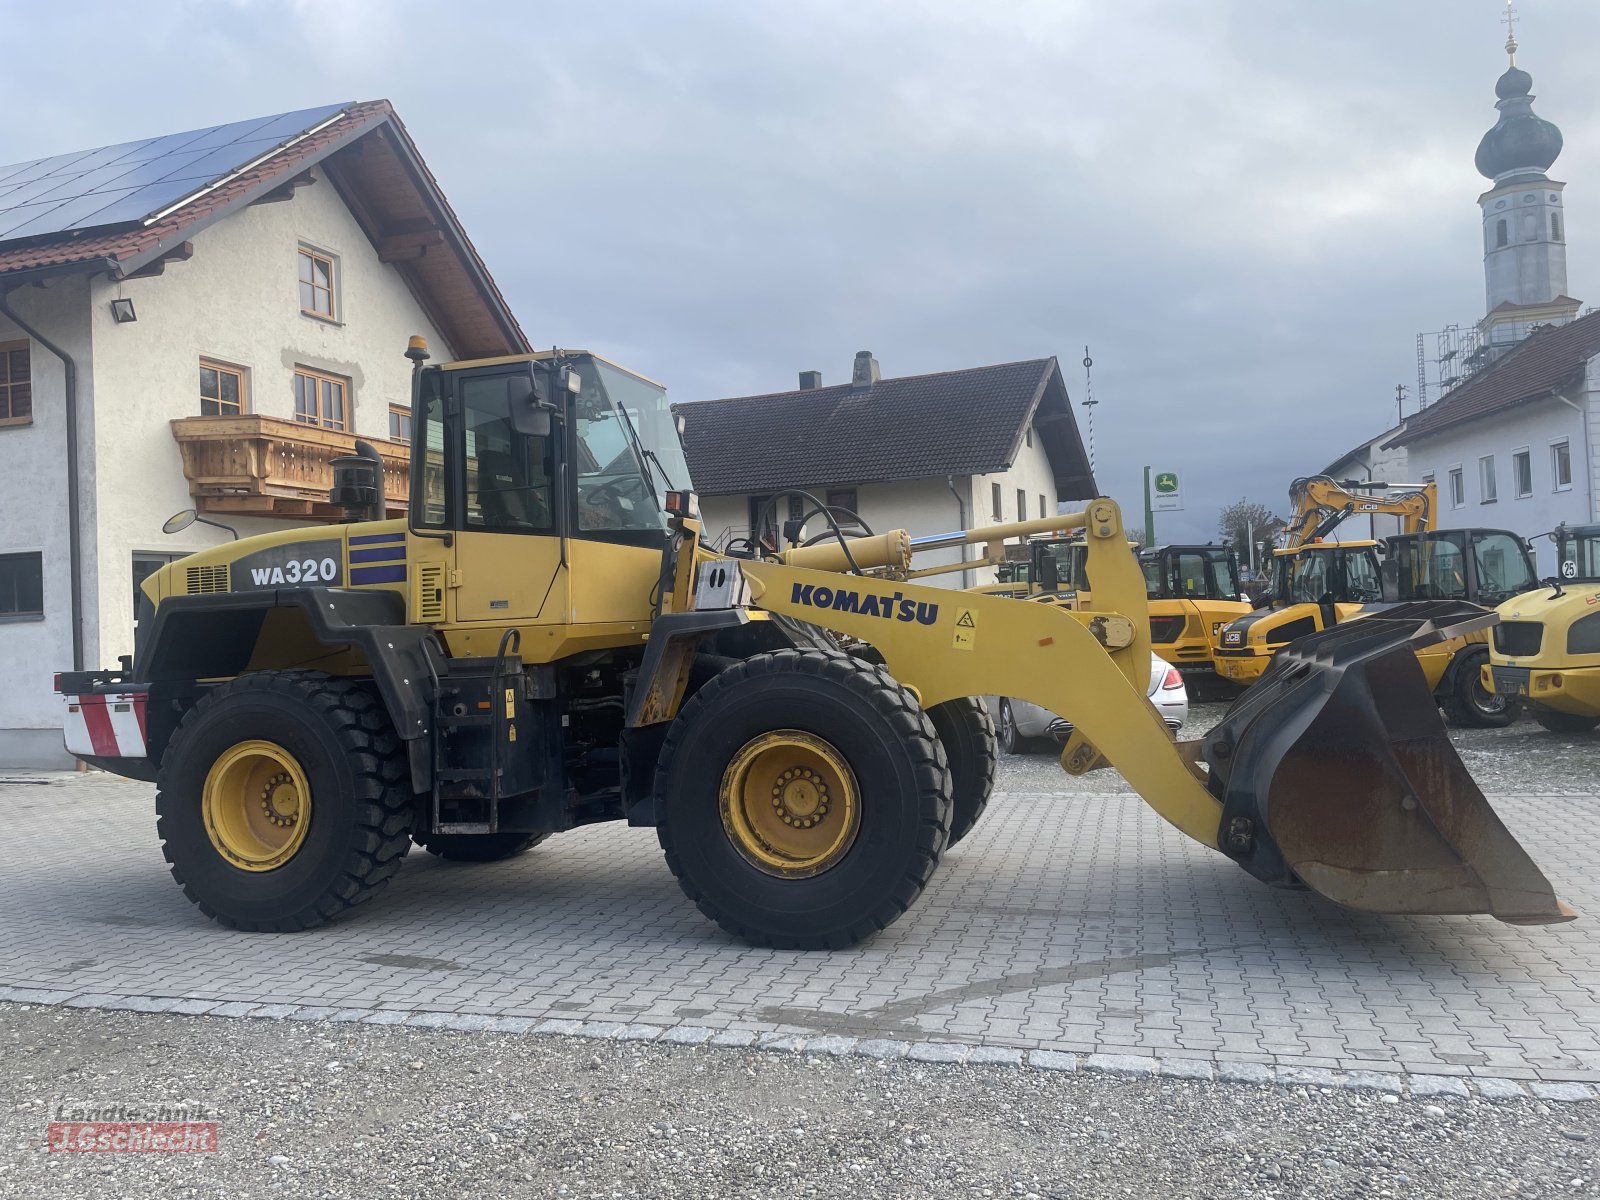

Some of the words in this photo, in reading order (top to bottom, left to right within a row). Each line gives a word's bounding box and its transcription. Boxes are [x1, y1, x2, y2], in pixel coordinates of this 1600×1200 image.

[251, 558, 337, 585] WA320
[1564, 562, 1575, 576] 25
[791, 583, 938, 625] KOMATSU
[1226, 633, 1240, 642] JCB
